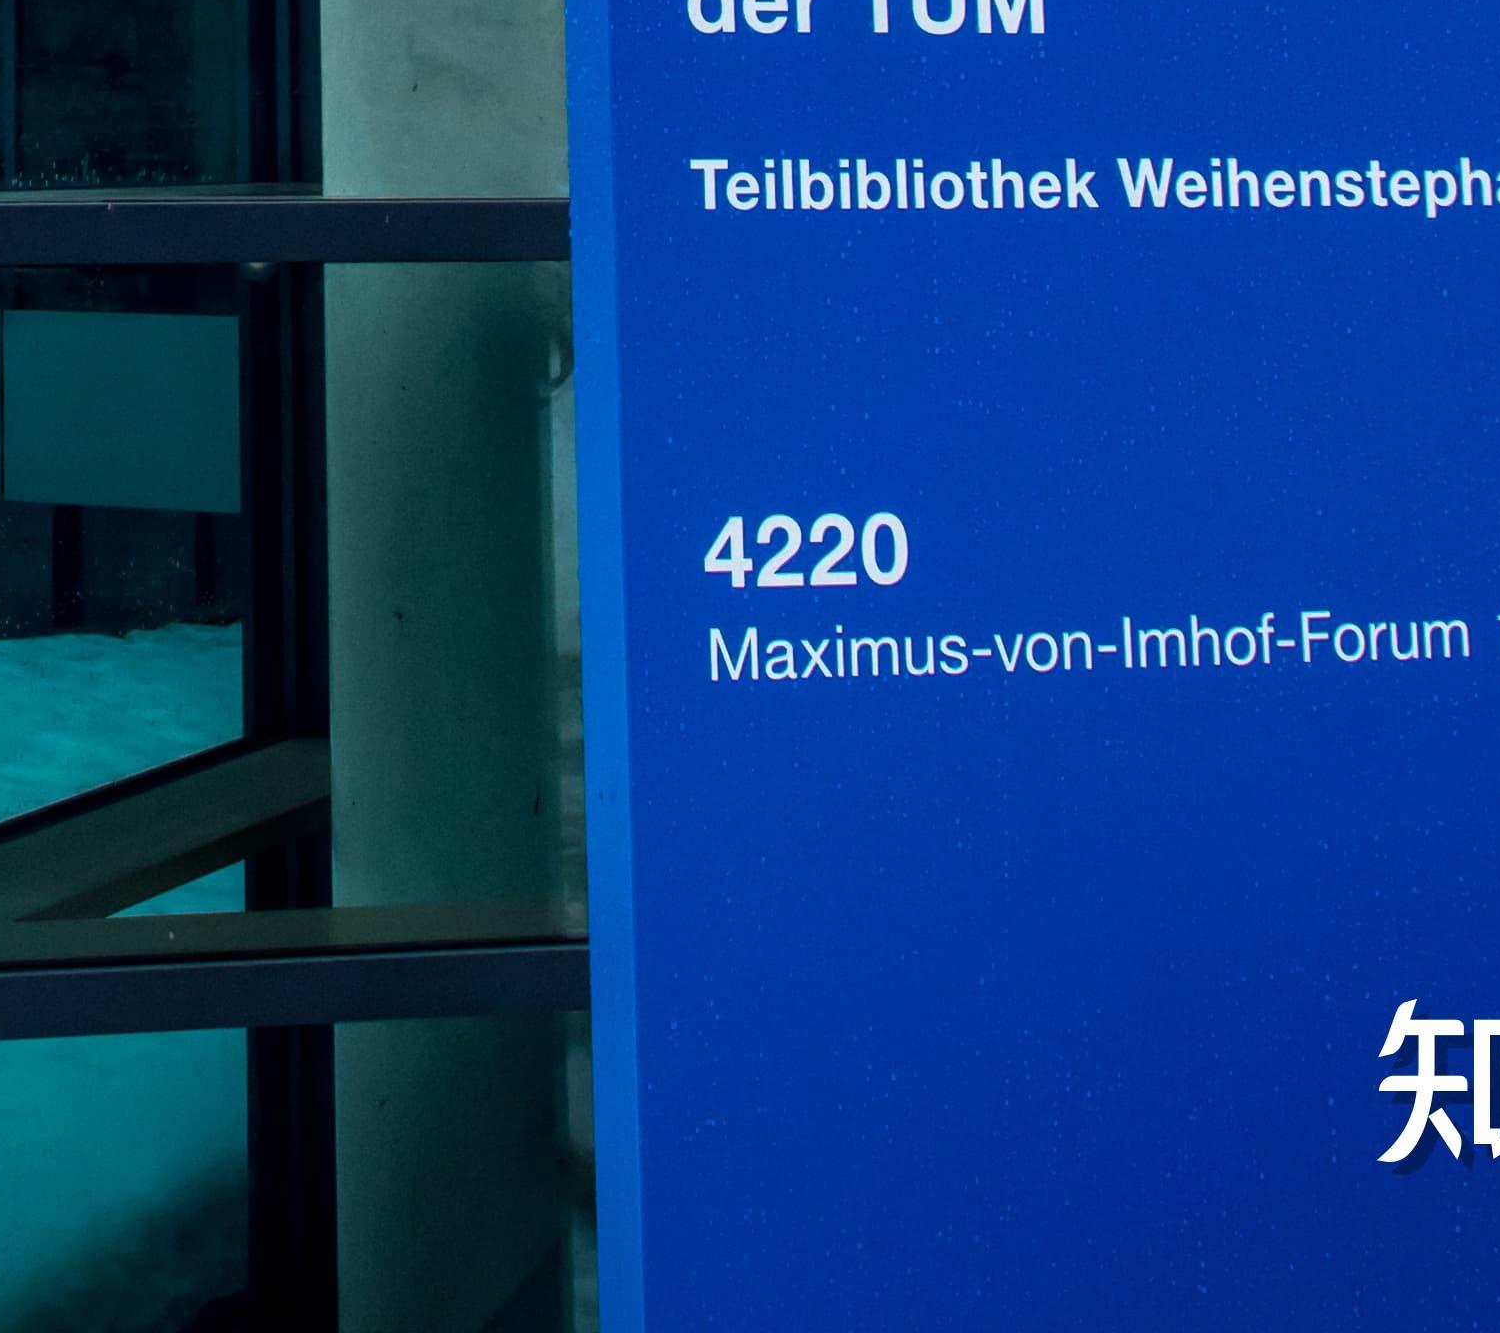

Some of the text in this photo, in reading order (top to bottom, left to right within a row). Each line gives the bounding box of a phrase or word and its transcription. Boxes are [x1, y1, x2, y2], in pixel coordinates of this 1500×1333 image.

[689, 157, 1100, 212] Teilbibliothek
[703, 512, 910, 589] 4220
[708, 611, 1471, 683] Maximus-von-Imhof-Forum
